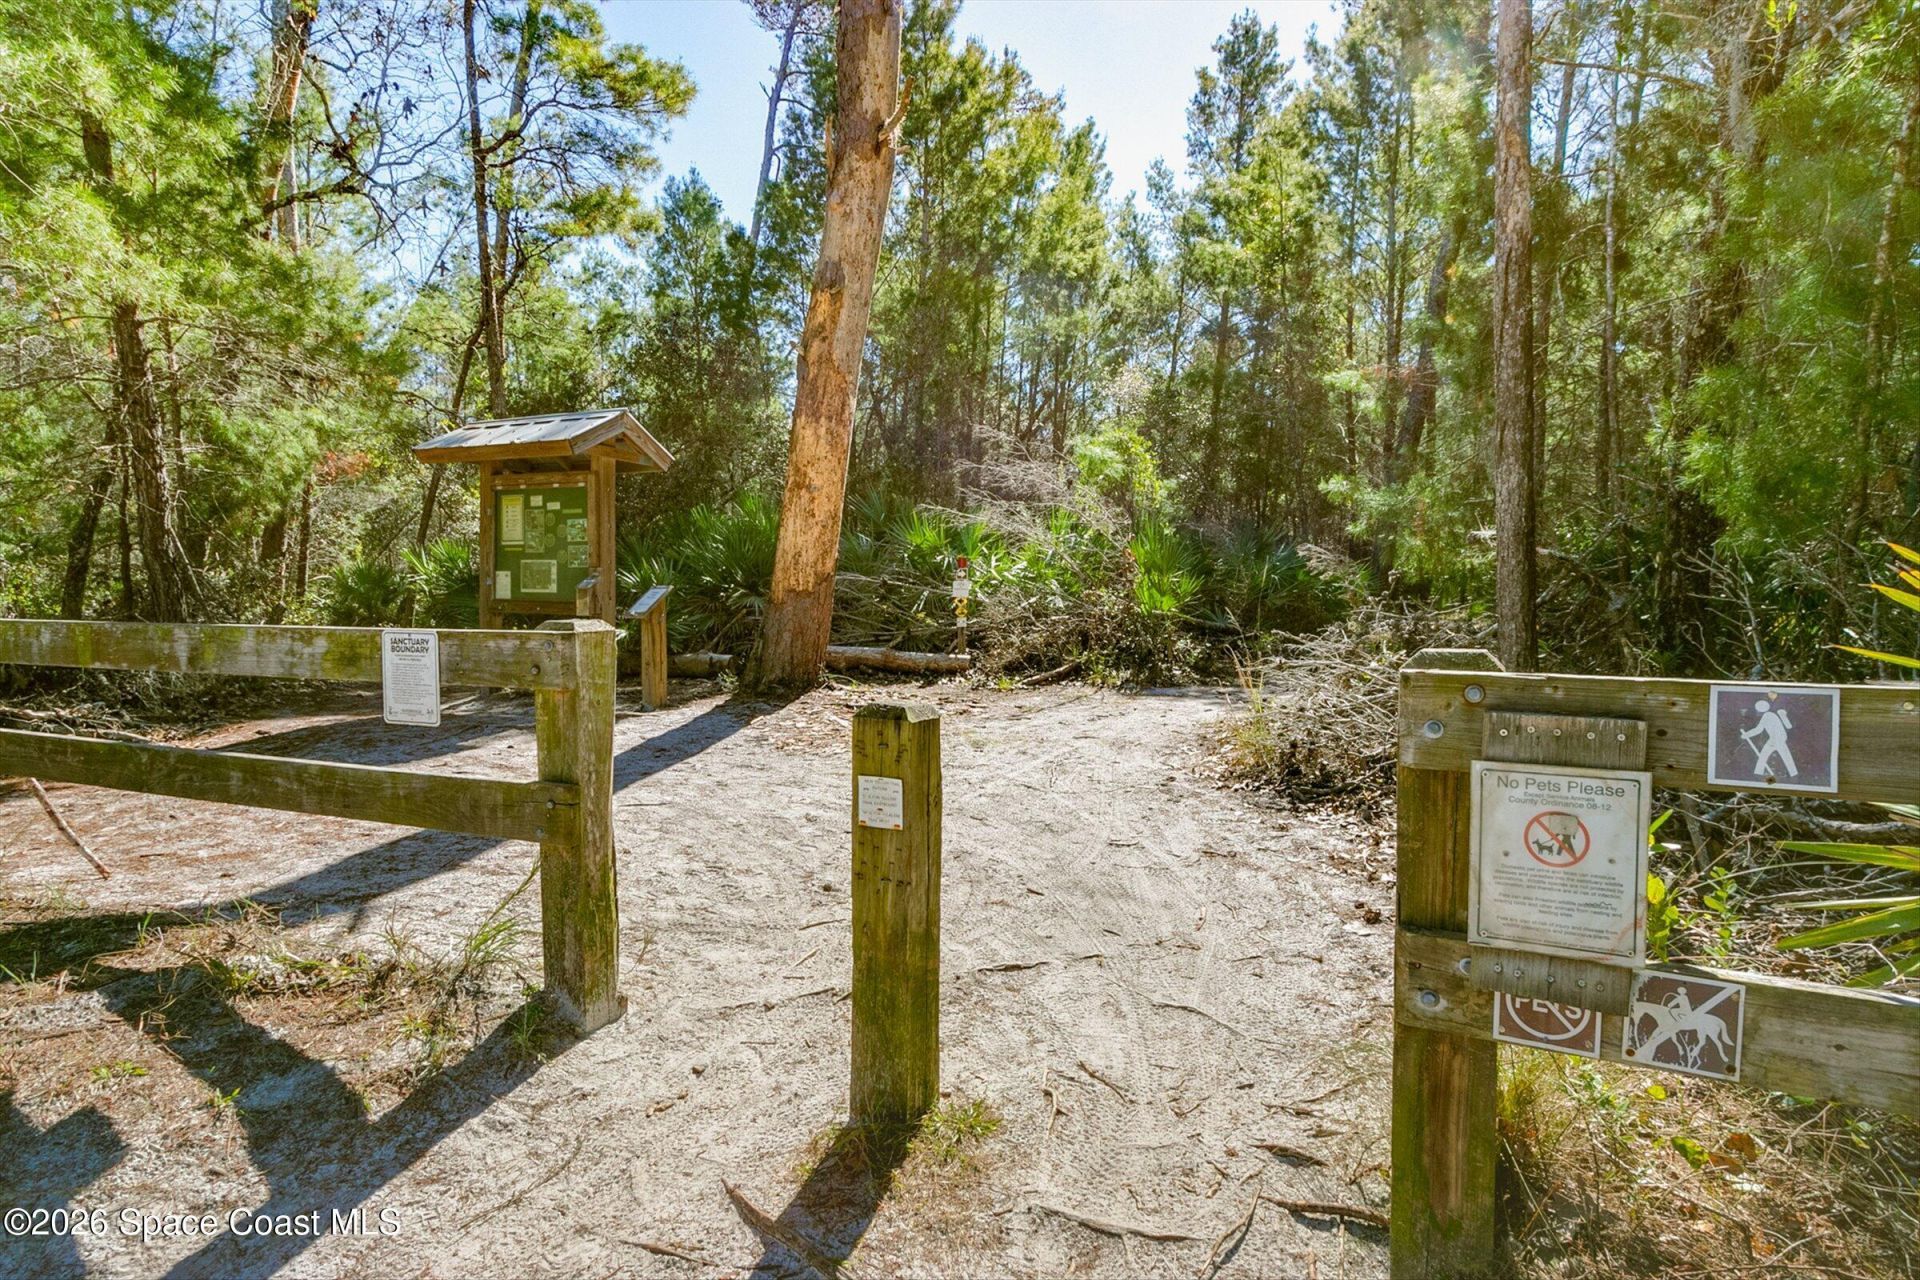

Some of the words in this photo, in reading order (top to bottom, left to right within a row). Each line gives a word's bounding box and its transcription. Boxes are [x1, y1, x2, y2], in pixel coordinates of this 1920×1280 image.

[390, 636, 430, 646] SANCTUARY
[390, 645, 430, 654] BOUNDARY
[1497, 776, 1519, 789] No
[1525, 777, 1561, 792] Pets
[1568, 781, 1625, 797] Please
[1508, 795, 1537, 806] County
[1541, 797, 1584, 809] Ordinance
[1524, 791, 1544, 799] Except
[1547, 793, 1569, 801] Service
[1571, 795, 1596, 803] Animals
[1515, 996, 1582, 1020] PES
